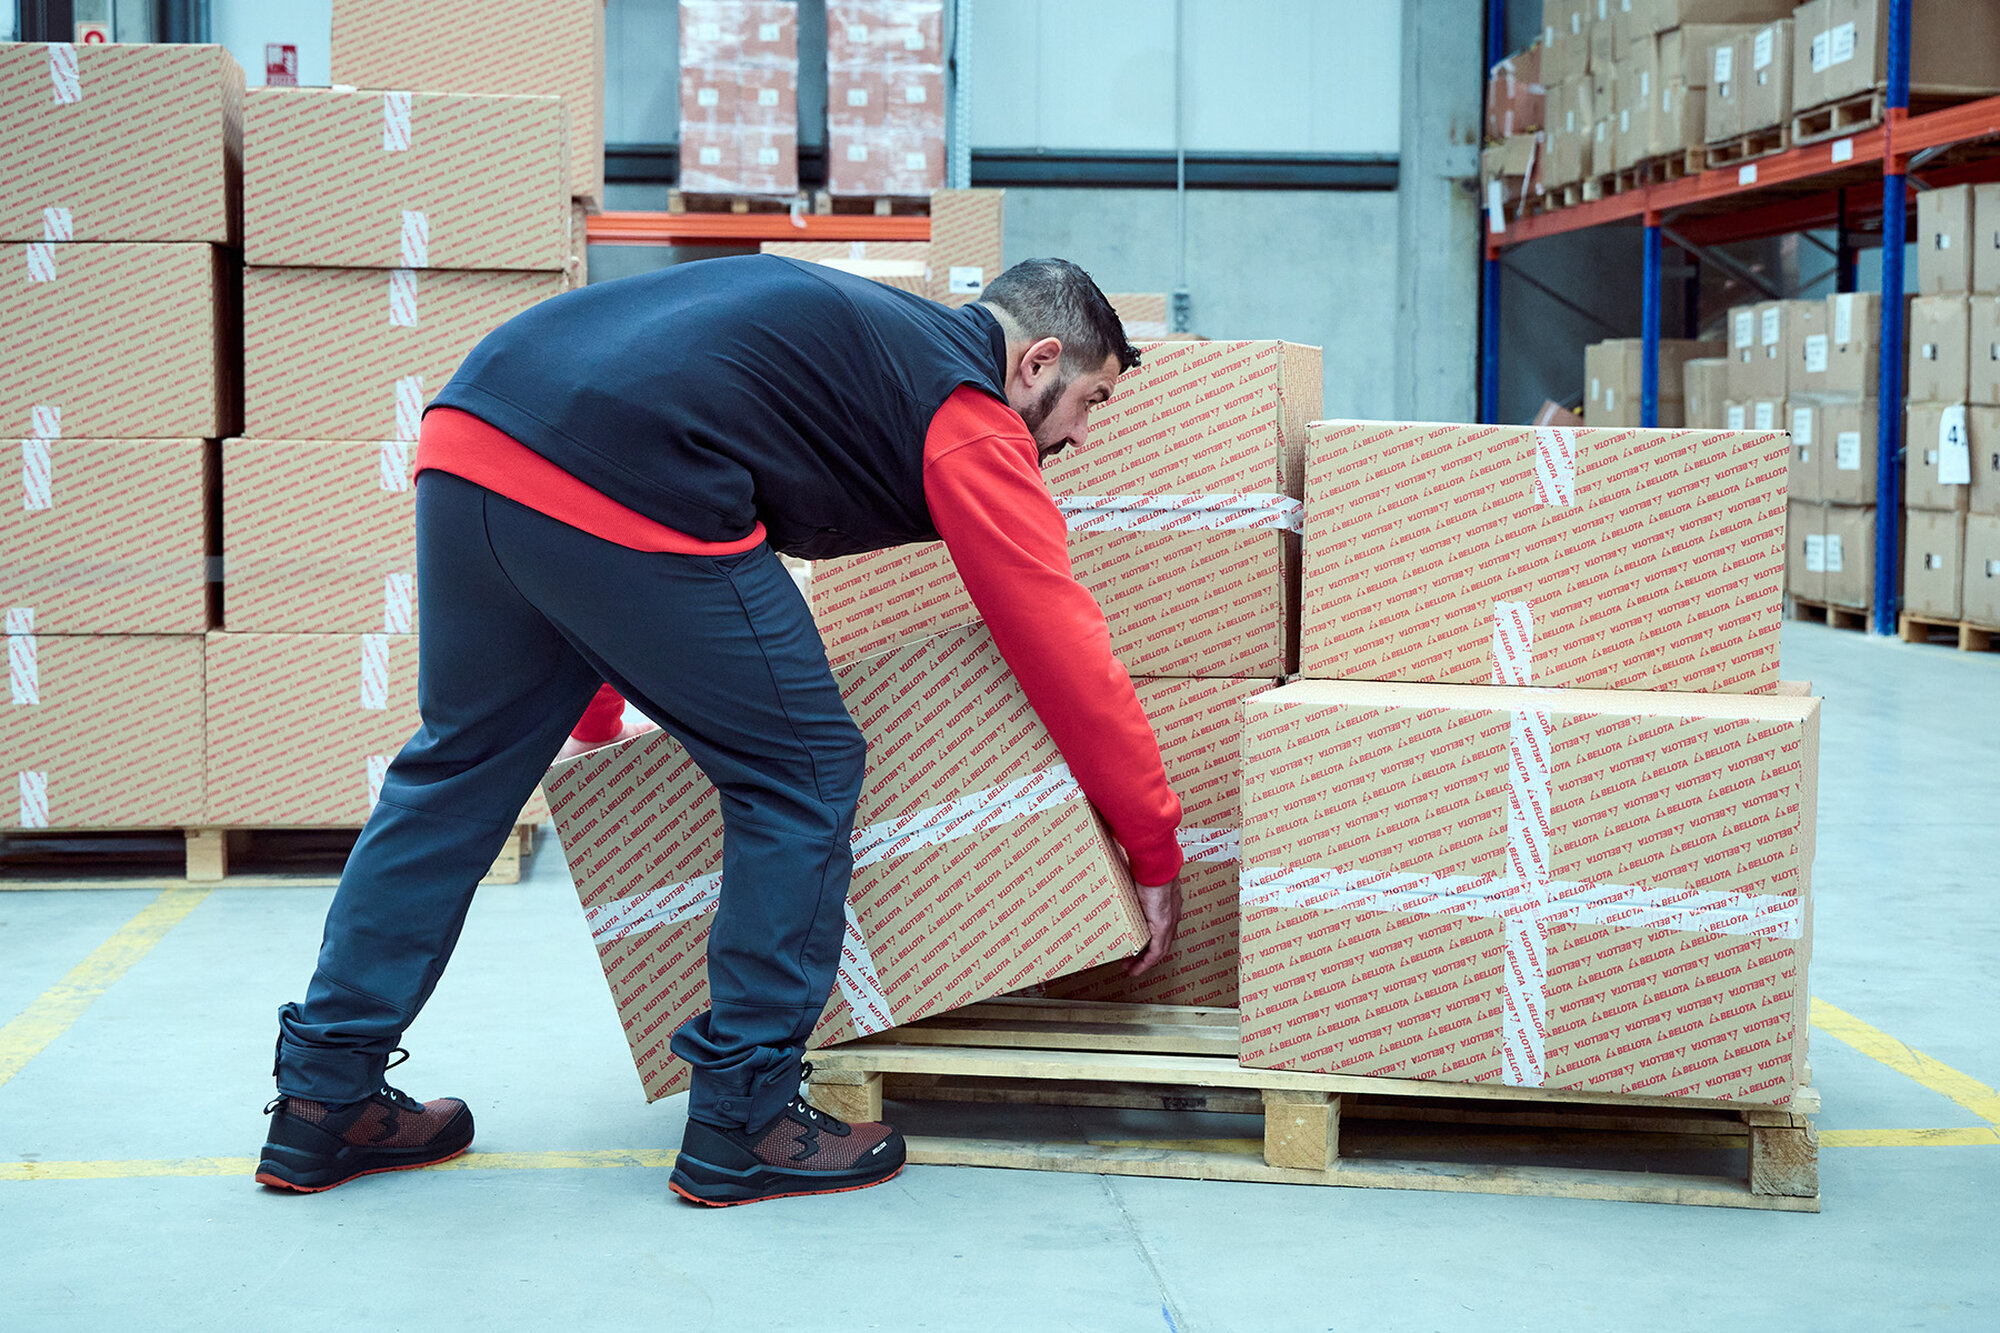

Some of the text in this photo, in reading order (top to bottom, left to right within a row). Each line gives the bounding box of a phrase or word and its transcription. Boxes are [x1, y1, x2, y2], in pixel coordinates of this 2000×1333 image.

[1156, 350, 1185, 366] BELLOTA
[1205, 383, 1234, 399] BELLOTA
[1161, 402, 1191, 418] BELLOTA
[1217, 414, 1247, 430] BELLOTA
[1137, 432, 1166, 447] BELLOTA
[1324, 426, 1355, 442] BELLOTA
[1743, 433, 1774, 450] BELLOTA
[1230, 446, 1259, 462] BELLOTA
[1382, 441, 1413, 456] BELLOTA
[1654, 448, 1686, 465] BELLOTA
[1094, 450, 1123, 466] BELLOTA
[1441, 456, 1472, 471] BELLOTA
[1586, 455, 1618, 472] BELLOTA
[1051, 468, 1080, 484] BELLOTA
[1186, 464, 1216, 480] BELLOTA
[1715, 463, 1747, 480] BELLOTA
[1107, 482, 1135, 496] BELLOTA
[1667, 482, 1699, 498] BELLOTA
[1349, 491, 1380, 507] BELLOTA
[1493, 491, 1523, 508] BELLOTA
[1728, 496, 1760, 513] BELLOTA
[1619, 500, 1651, 516] BELLOTA
[1679, 515, 1712, 532] BELLOTA
[1144, 535, 1173, 551] BELLOTA
[1420, 538, 1451, 554] BELLOTA
[1524, 536, 1557, 552] BELLOTA
[1632, 533, 1664, 549] BELLOTA
[1200, 548, 1229, 564] BELLOTA
[1354, 545, 1384, 560] BELLOTA
[1584, 551, 1617, 567] BELLOTA
[1733, 552, 1765, 568] BELLOTA
[910, 562, 937, 578] BELLOTA
[1644, 566, 1677, 582] BELLOTA
[1114, 584, 1144, 600] BELLOTA
[1213, 580, 1242, 596] BELLOTA
[1746, 585, 1778, 602] BELLOTA
[828, 597, 856, 612] BELLOTA
[1321, 594, 1351, 610] BELLOTA
[1386, 589, 1417, 604] BELLOTA
[941, 604, 968, 618] BELLOTA
[1170, 598, 1199, 614] BELLOTA
[1445, 604, 1476, 620] BELLOTA
[1550, 602, 1582, 618] BELLOTA
[1698, 603, 1729, 620] BELLOTA
[1226, 611, 1256, 627] BELLOTA
[1609, 618, 1642, 633] BELLOTA
[1147, 627, 1176, 642] BELLOTA
[1670, 633, 1703, 648] BELLOTA
[1353, 638, 1384, 654] BELLOTA
[899, 649, 927, 672] BELLOTA
[1411, 654, 1442, 670] BELLOTA
[1622, 650, 1655, 666] BELLOTA
[1731, 649, 1763, 664] BELLOTA
[961, 665, 988, 691] BELLOTA
[1575, 668, 1608, 684] BELLOTA
[1683, 666, 1715, 682] BELLOTA
[1189, 688, 1217, 702] BELLOTA
[923, 700, 950, 724] BELLOTA
[1305, 706, 1337, 722] BELLOTA
[1165, 717, 1193, 731] BELLOTA
[1368, 723, 1400, 739] BELLOTA
[1639, 723, 1673, 740] BELLOTA
[1758, 722, 1793, 739] BELLOTA
[885, 733, 912, 757] BELLOTA
[1431, 740, 1463, 756] BELLOTA
[1524, 727, 1542, 762] BELLOTA
[1588, 742, 1621, 760] BELLOTA
[1705, 741, 1740, 758] BELLOTA
[586, 759, 611, 783] BELLOTA
[971, 756, 998, 780] BELLOTA
[1311, 764, 1343, 780] BELLOTA
[1512, 747, 1530, 783] BELLOTA
[1653, 760, 1687, 777] BELLOTA
[871, 771, 898, 794] BELLOTA
[1190, 780, 1218, 794] BELLOTA
[1373, 781, 1405, 798] BELLOTA
[1444, 776, 1478, 792] BELLOTA
[1558, 775, 1592, 790] BELLOTA
[1719, 778, 1755, 795] BELLOTA
[668, 782, 693, 806] BELLOTA
[1624, 792, 1658, 809] BELLOTA
[572, 797, 598, 820] BELLOTA
[631, 814, 657, 838] BELLOTA
[1276, 817, 1308, 834] BELLOTA
[1458, 812, 1490, 828] BELLOTA
[1532, 801, 1550, 836] BELLOTA
[1572, 811, 1606, 828] BELLOTA
[1734, 814, 1769, 832] BELLOTA
[1338, 834, 1370, 851] BELLOTA
[1408, 830, 1441, 846] BELLOTA
[1522, 827, 1541, 863] BELLOTA
[1638, 829, 1672, 845] BELLOTA
[951, 842, 978, 866] BELLOTA
[1013, 838, 1040, 862] BELLOTA
[1471, 848, 1505, 864] BELLOTA
[1586, 848, 1620, 863] BELLOTA
[617, 852, 643, 874] BELLOTA
[1748, 852, 1784, 869] BELLOTA
[913, 874, 940, 898] BELLOTA
[1060, 871, 1087, 894] BELLOTA
[1357, 871, 1391, 888] BELLOTA
[1695, 870, 1731, 887] BELLOTA
[851, 879, 878, 903] BELLOTA
[1198, 880, 1226, 894] BELLOTA
[998, 898, 1025, 922] BELLOTA
[1504, 901, 1541, 917] BELLOTA
[1084, 922, 1111, 946] BELLOTA
[1307, 924, 1340, 940] BELLOTA
[1574, 930, 1608, 946] BELLOTA
[657, 930, 683, 952] BELLOTA
[898, 935, 925, 959] BELLOTA
[983, 936, 1010, 959] BELLOTA
[1187, 940, 1215, 954] BELLOTA
[1520, 930, 1538, 966] BELLOTA
[1370, 942, 1402, 957] BELLOTA
[1640, 948, 1674, 964] BELLOTA
[1714, 944, 1750, 959] BELLOTA
[1433, 960, 1465, 976] BELLOTA
[1507, 951, 1525, 986] BELLOTA
[884, 972, 911, 995] BELLOTA
[945, 968, 972, 991] BELLOTA
[1273, 976, 1305, 991] BELLOTA
[681, 980, 706, 1004] BELLOTA
[1655, 984, 1688, 1000] BELLOTA
[1729, 980, 1765, 996] BELLOTA
[1335, 994, 1367, 1010] BELLOTA
[1447, 996, 1479, 1011] BELLOTA
[1560, 997, 1594, 1012] BELLOTA
[644, 1011, 670, 1035] BELLOTA
[1528, 1003, 1545, 1039] BELLOTA
[1669, 1020, 1703, 1037] BELLOTA
[1743, 1017, 1779, 1032] BELLOTA
[1279, 1033, 1311, 1049] BELLOTA
[1349, 1030, 1381, 1044] BELLOTA
[1574, 1032, 1608, 1048] BELLOTA
[1518, 1028, 1536, 1064] BELLOTA
[1411, 1048, 1444, 1064] BELLOTA
[1505, 1048, 1523, 1083] BELLOTA
[1683, 1057, 1717, 1073] BELLOTA
[1589, 1068, 1623, 1084] BELLOTA
[1749, 1076, 1785, 1092] BELLOTA
